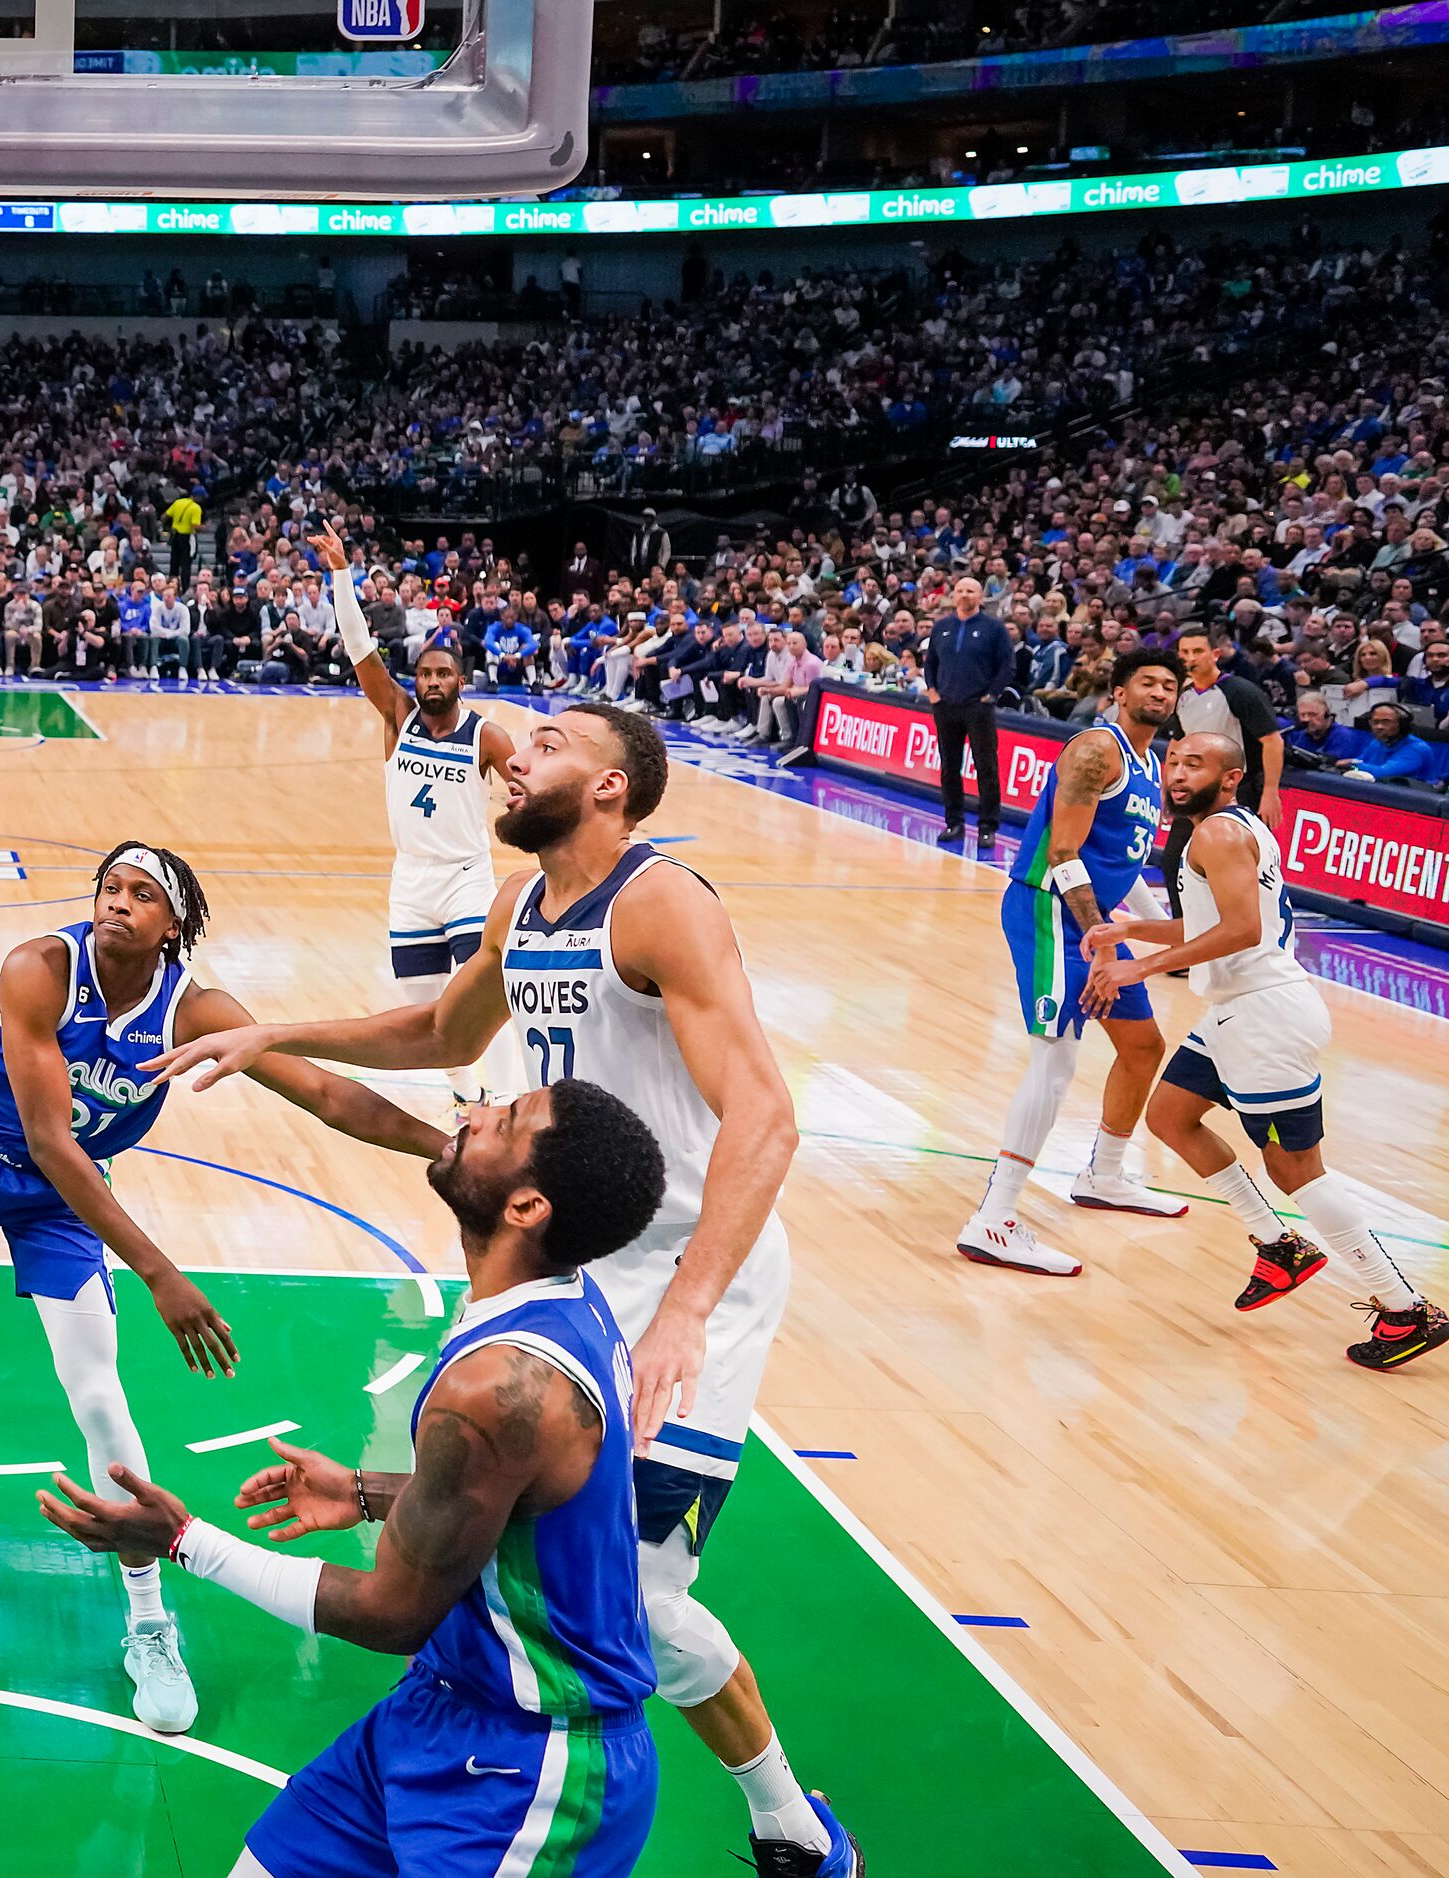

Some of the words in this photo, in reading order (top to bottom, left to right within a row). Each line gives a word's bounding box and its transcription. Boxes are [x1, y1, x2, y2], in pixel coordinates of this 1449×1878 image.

[351, 0, 391, 27] NBA
[1303, 166, 1381, 190] chime
[1084, 183, 1160, 206] chime
[690, 204, 758, 226] chime
[883, 195, 955, 218] chime
[157, 208, 219, 229] chime
[330, 210, 392, 231] chime
[506, 208, 571, 229] chime
[819, 702, 899, 759] PERFICIENT
[397, 757, 467, 783] WOLVES
[410, 783, 437, 818] 4
[78, 986, 90, 1004] 6
[507, 980, 590, 1014] WOLVES
[127, 1030, 163, 1045] chime
[67, 1057, 158, 1108] allas
